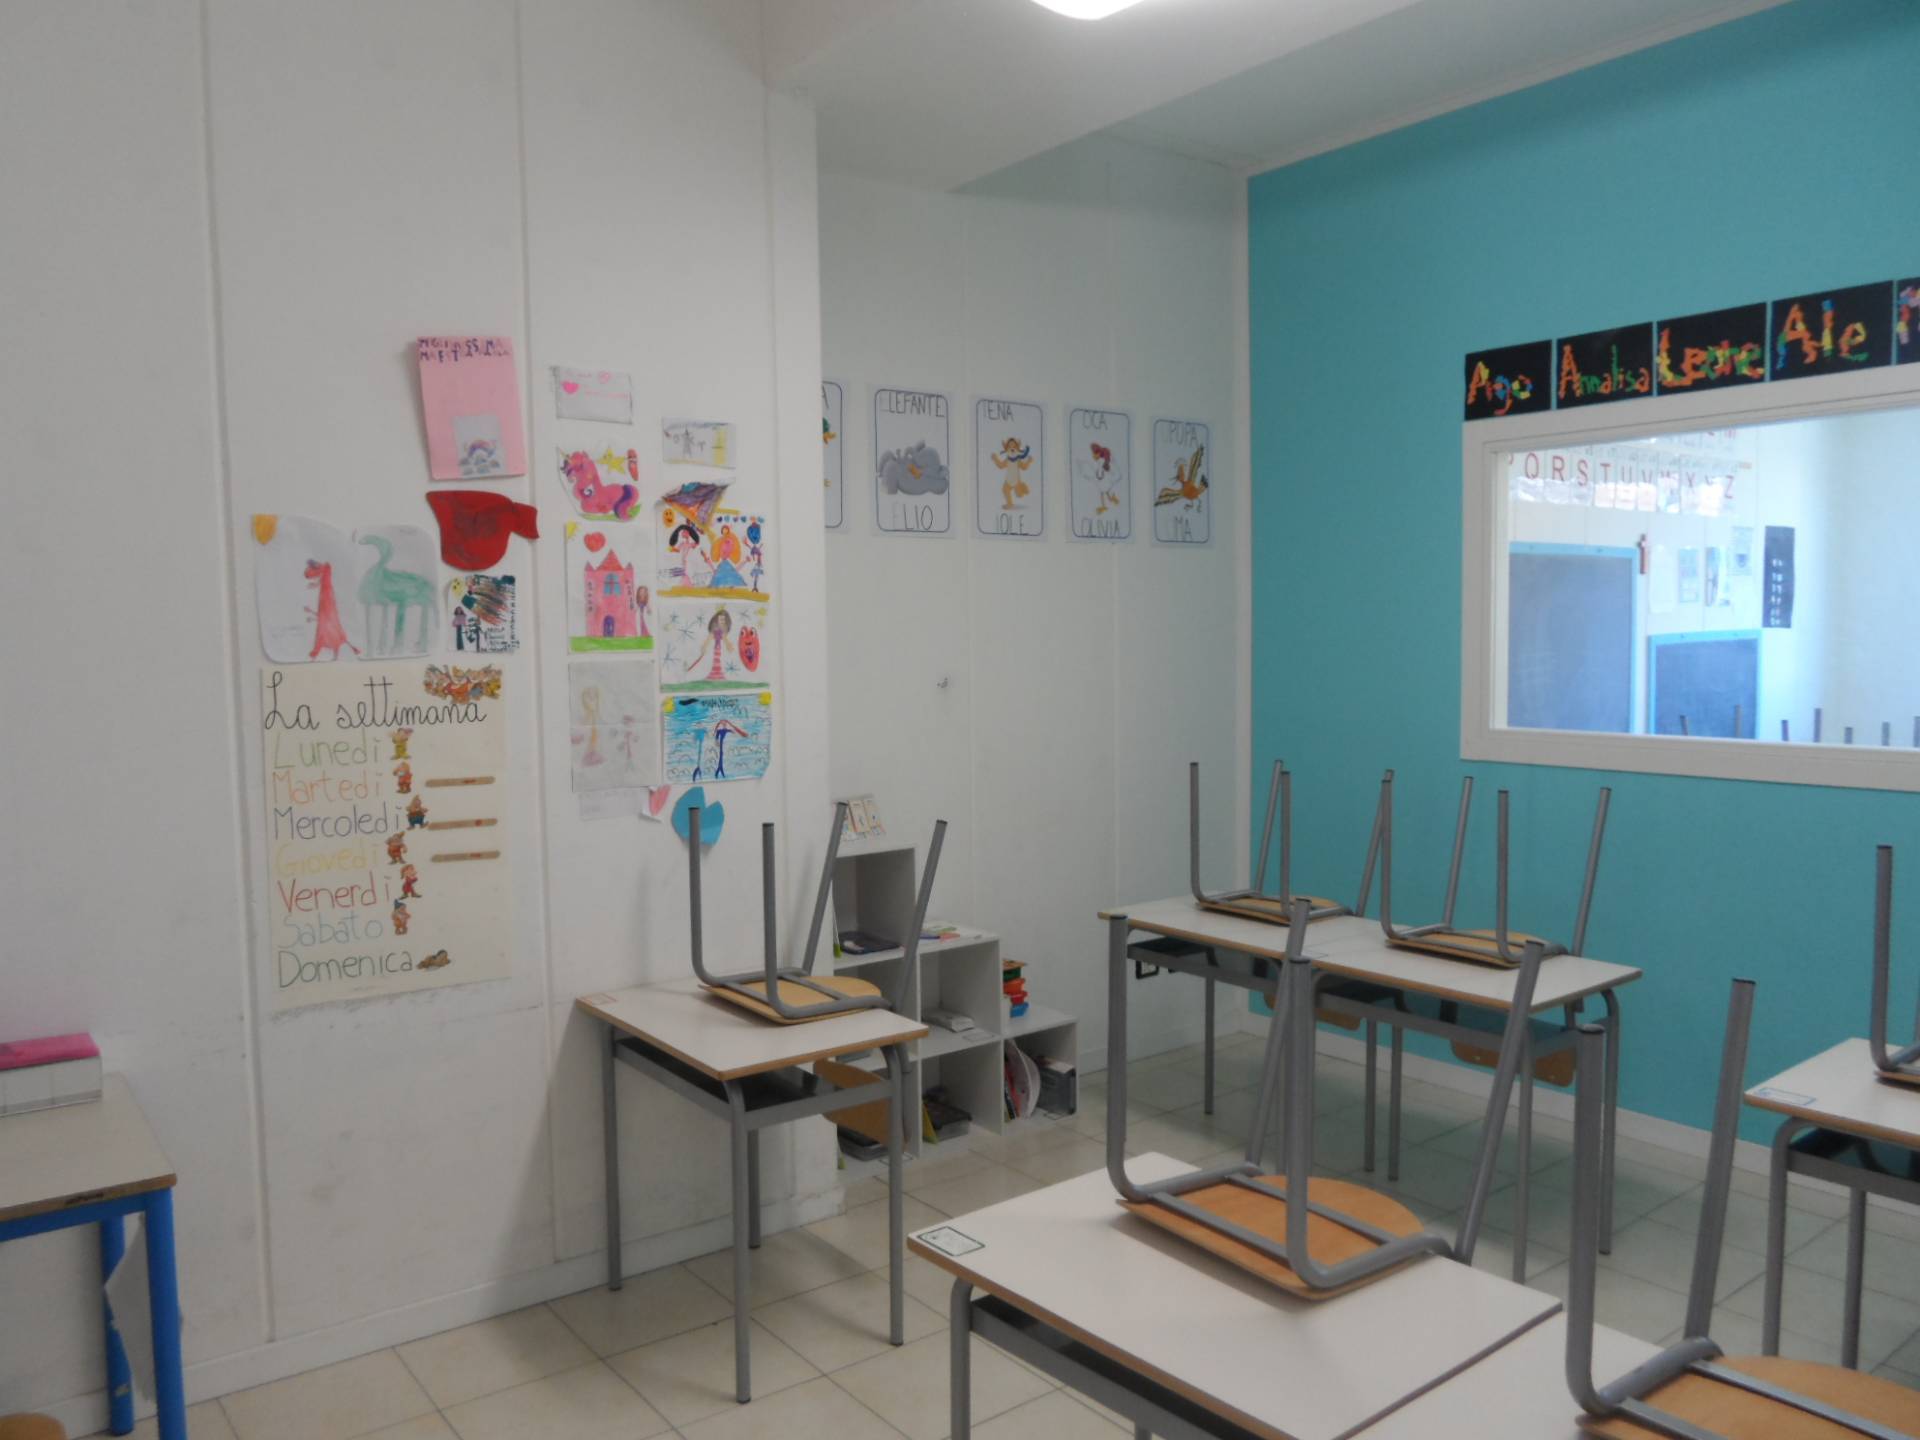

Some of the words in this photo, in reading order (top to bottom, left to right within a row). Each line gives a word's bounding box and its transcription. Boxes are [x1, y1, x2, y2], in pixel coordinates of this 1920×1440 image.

[1776, 299, 1869, 370] Ale
[1467, 360, 1534, 416] Ago
[1558, 344, 1651, 399] Annalisa
[264, 671, 320, 730] La
[336, 676, 487, 729] settimana
[277, 912, 384, 949] Sabato
[278, 950, 413, 988] Domenica
